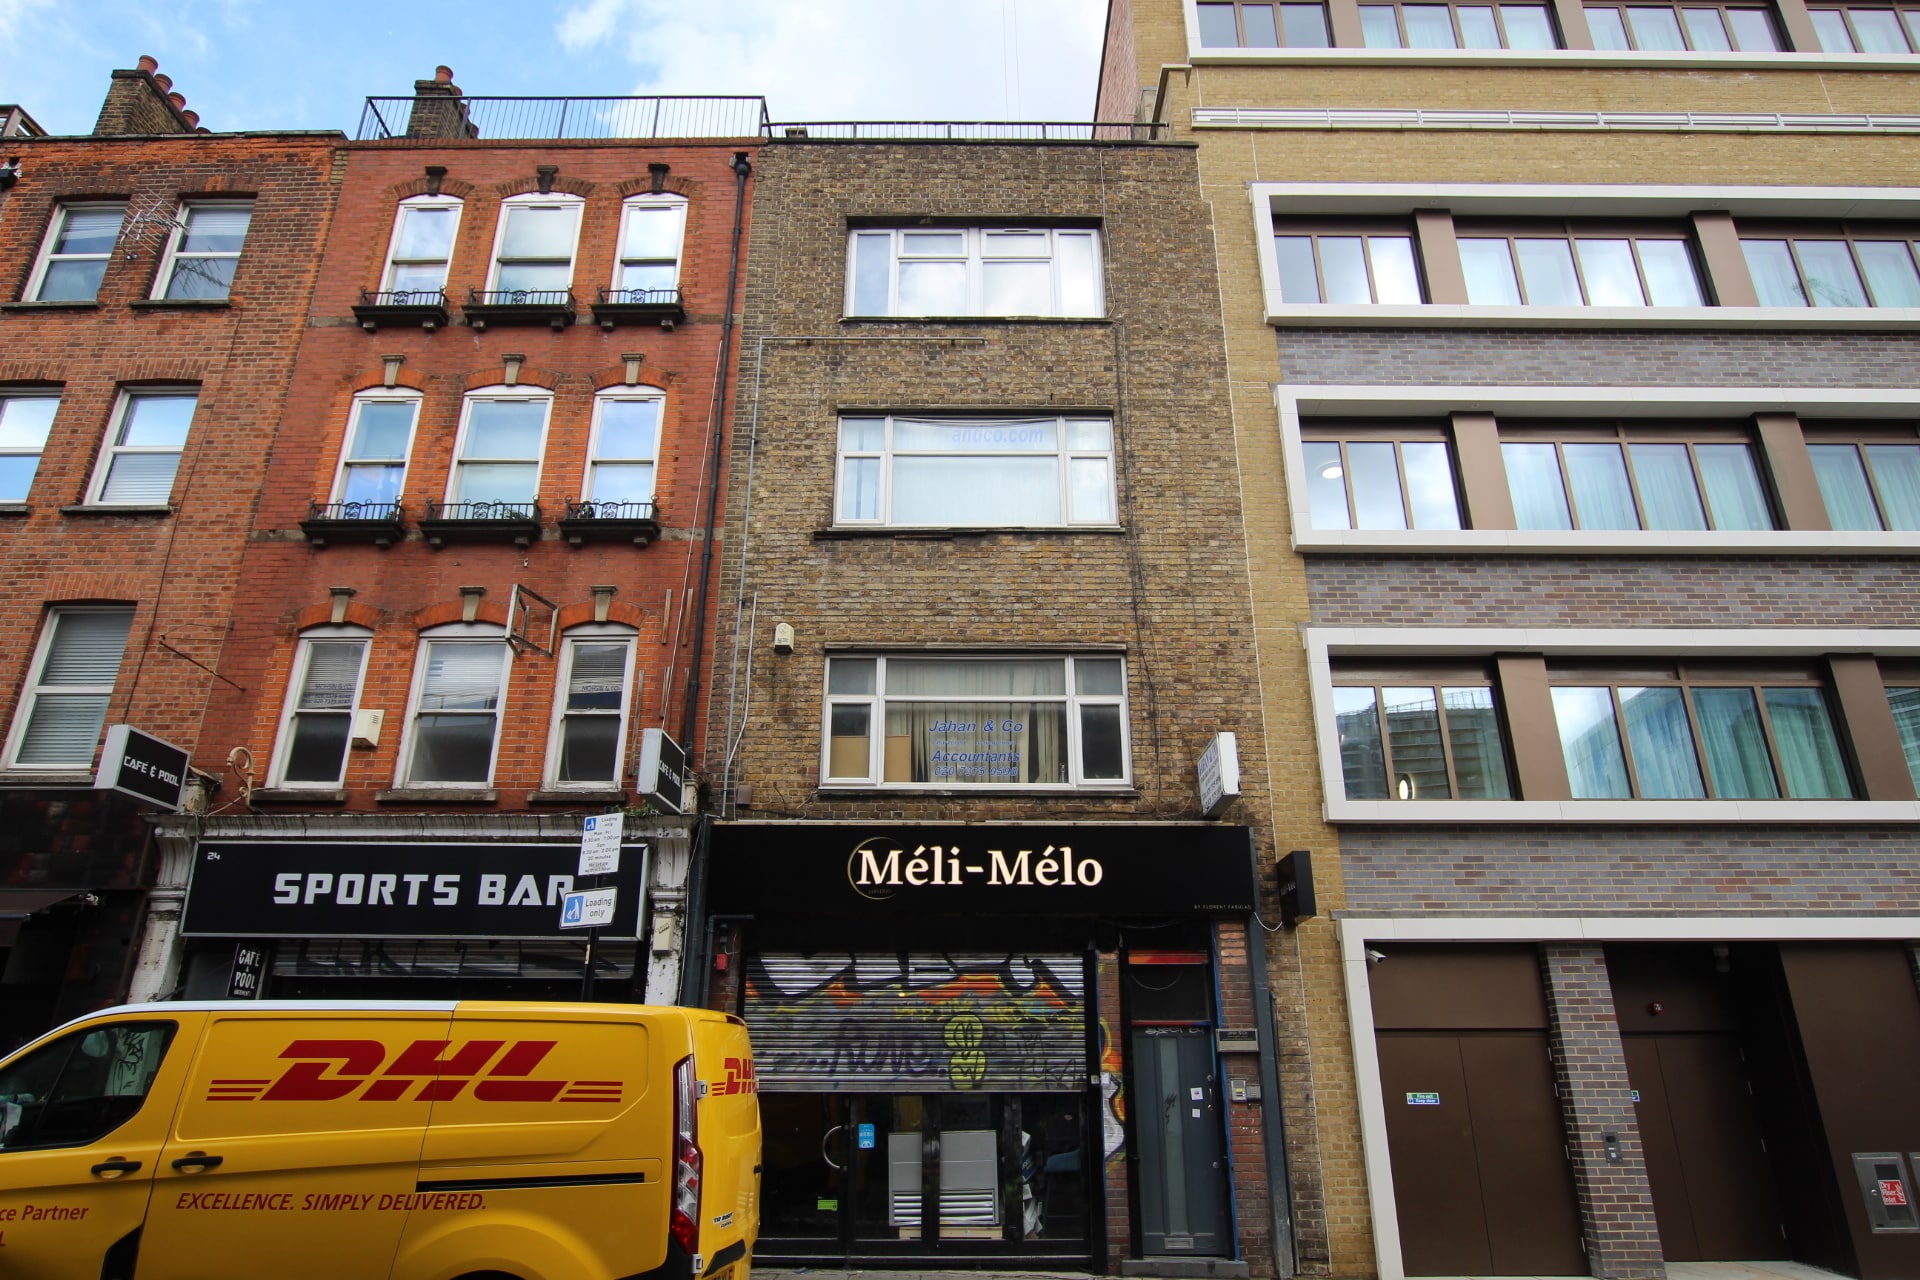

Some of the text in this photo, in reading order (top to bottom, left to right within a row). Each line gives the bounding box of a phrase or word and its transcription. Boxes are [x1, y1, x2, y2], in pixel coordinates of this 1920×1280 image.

[929, 719, 1023, 732] Jahan & Co
[931, 749, 1020, 762] Accountants
[158, 768, 179, 786] POOL
[934, 766, 955, 777] 020
[207, 852, 220, 860] 24
[855, 845, 1104, 886] Méli-Mélo
[273, 873, 574, 906] SPORTS BAR
[585, 897, 612, 908] Loading
[590, 908, 606, 918] only
[234, 971, 256, 989] POOL
[259, 1040, 567, 1102] DHL
[176, 1192, 487, 1210] EXCELLENCE. SIMPLY DELIVERED.
[21, 1204, 88, 1220] Partner
